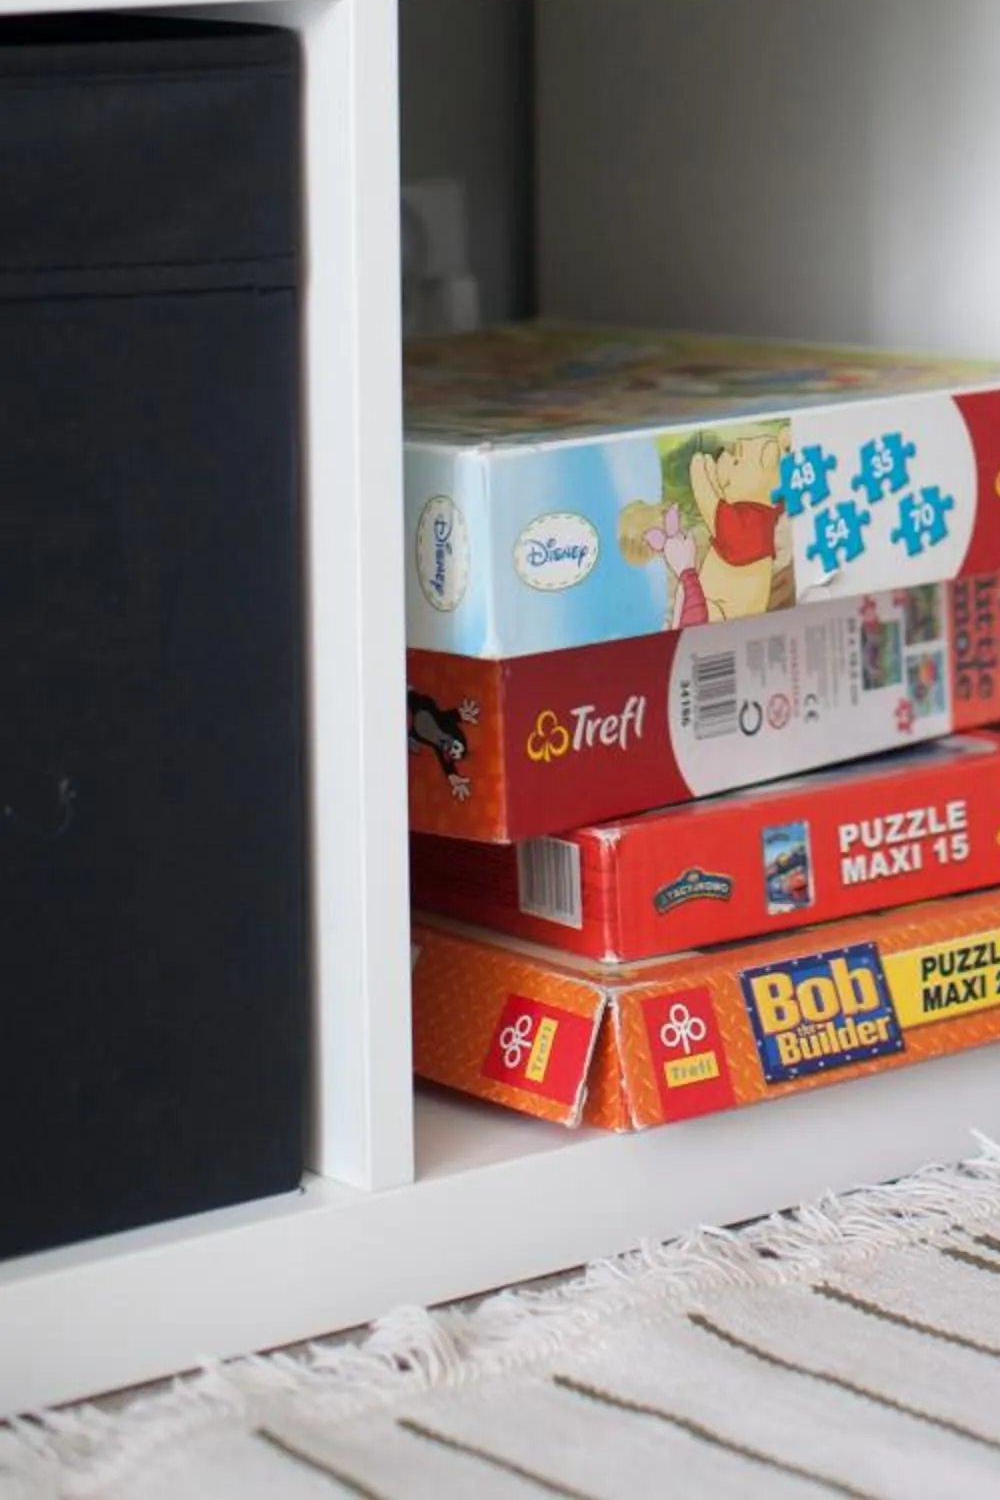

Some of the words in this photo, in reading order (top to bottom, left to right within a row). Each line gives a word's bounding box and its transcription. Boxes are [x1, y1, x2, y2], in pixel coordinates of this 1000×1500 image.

[790, 461, 816, 490] 48
[870, 450, 894, 479] 35
[825, 520, 850, 548] 54
[908, 503, 935, 532] 70
[526, 537, 590, 567] Disney
[569, 695, 647, 751] Trefl
[837, 800, 968, 852] PUZZLE
[841, 843, 922, 886] MAXI
[932, 832, 970, 864] 15
[750, 957, 881, 1034] Bob
[922, 971, 989, 1013] MAXI
[776, 1017, 891, 1066] Builder
